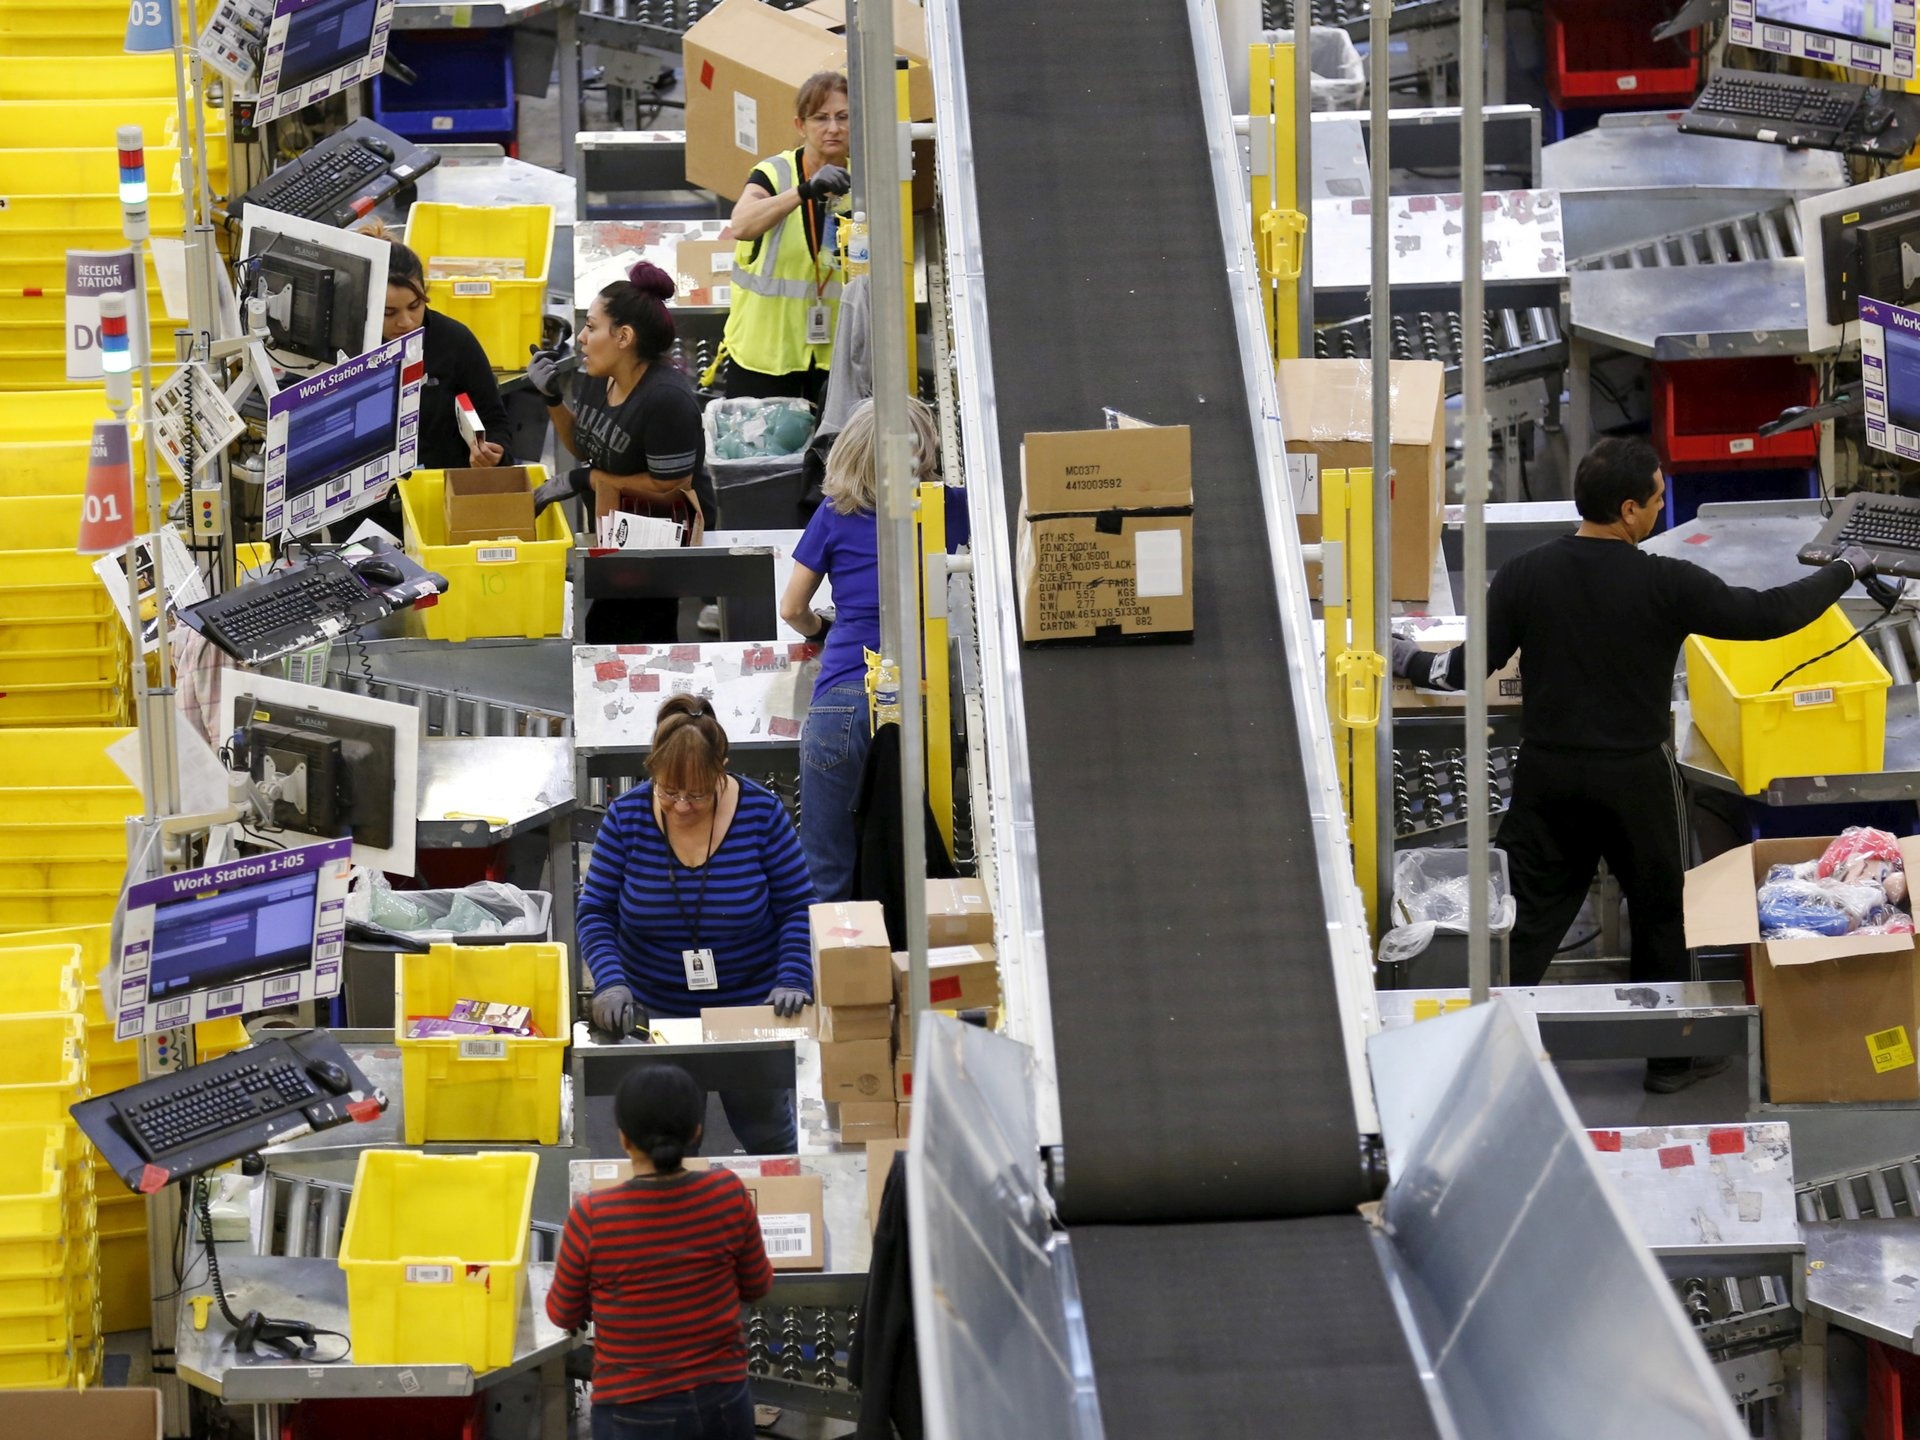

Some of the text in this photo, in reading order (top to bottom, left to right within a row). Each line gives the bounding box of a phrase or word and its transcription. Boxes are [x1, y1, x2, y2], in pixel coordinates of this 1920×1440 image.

[78, 264, 120, 276] RECEIVE
[77, 276, 122, 288] STATION
[1892, 311, 1920, 331] Work
[299, 363, 364, 400] Work Station
[1066, 465, 1100, 476] MC0377
[1066, 479, 1122, 490] 4413003592
[1040, 553, 1067, 562] STYLE
[1117, 587, 1136, 597] KGS
[1118, 598, 1137, 607] KGS
[295, 715, 328, 728] PLANAR
[173, 853, 305, 893] Work Station 1-i05
